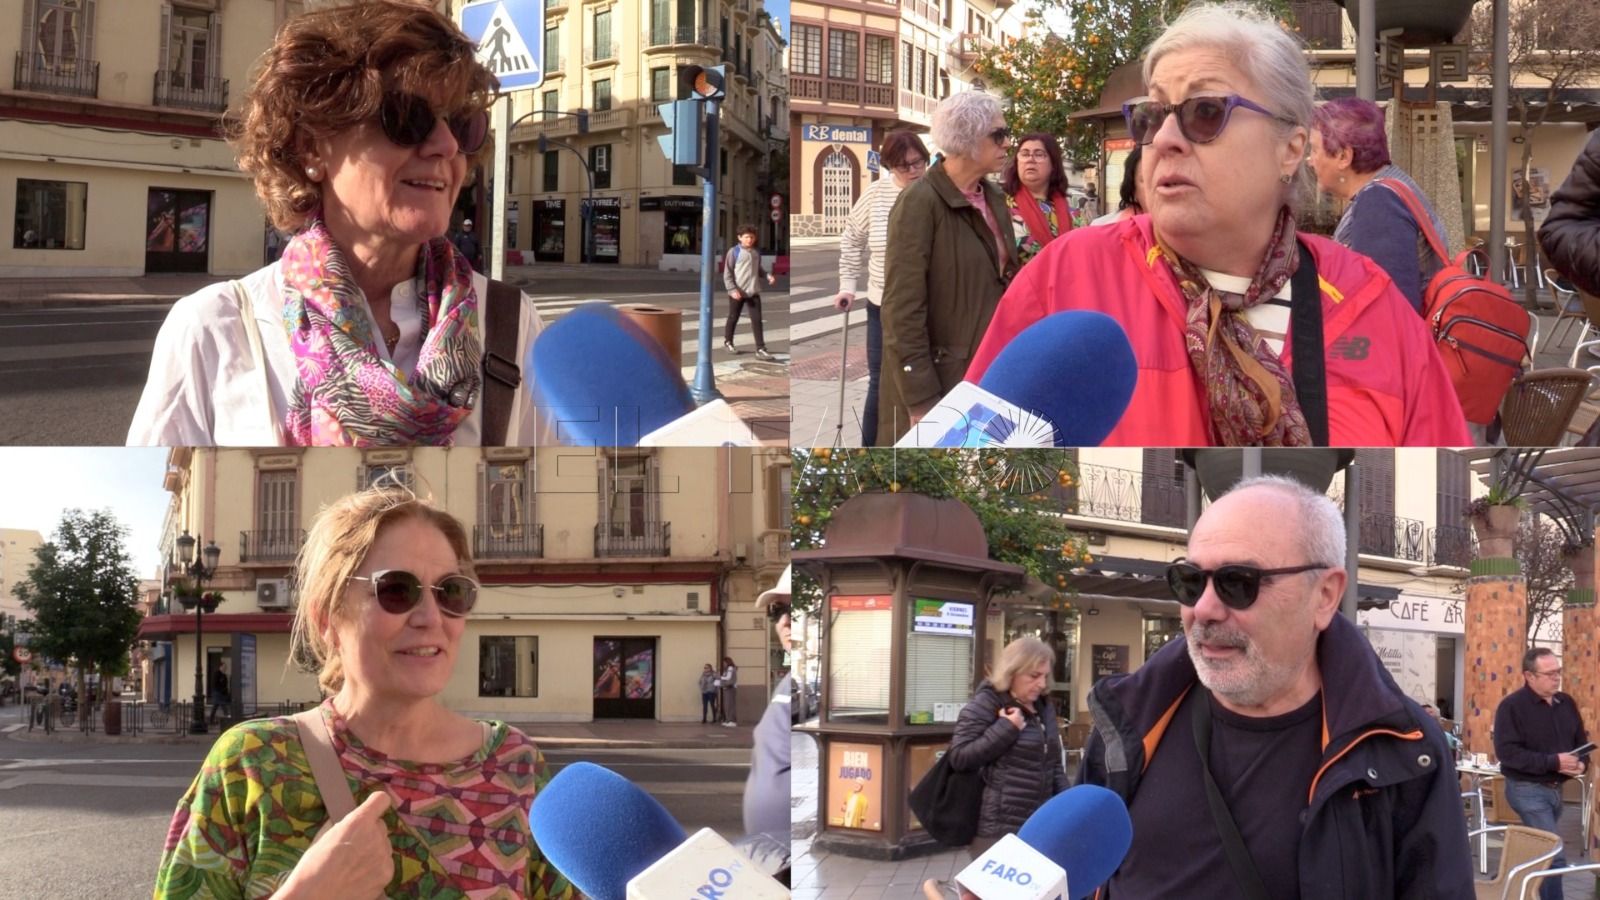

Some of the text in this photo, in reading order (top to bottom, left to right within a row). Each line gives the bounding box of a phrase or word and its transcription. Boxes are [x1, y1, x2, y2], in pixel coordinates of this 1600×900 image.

[809, 125, 867, 142] RB dental
[844, 751, 868, 767] BIEN
[839, 767, 872, 780] JUGADO
[982, 859, 1032, 885] FARO
